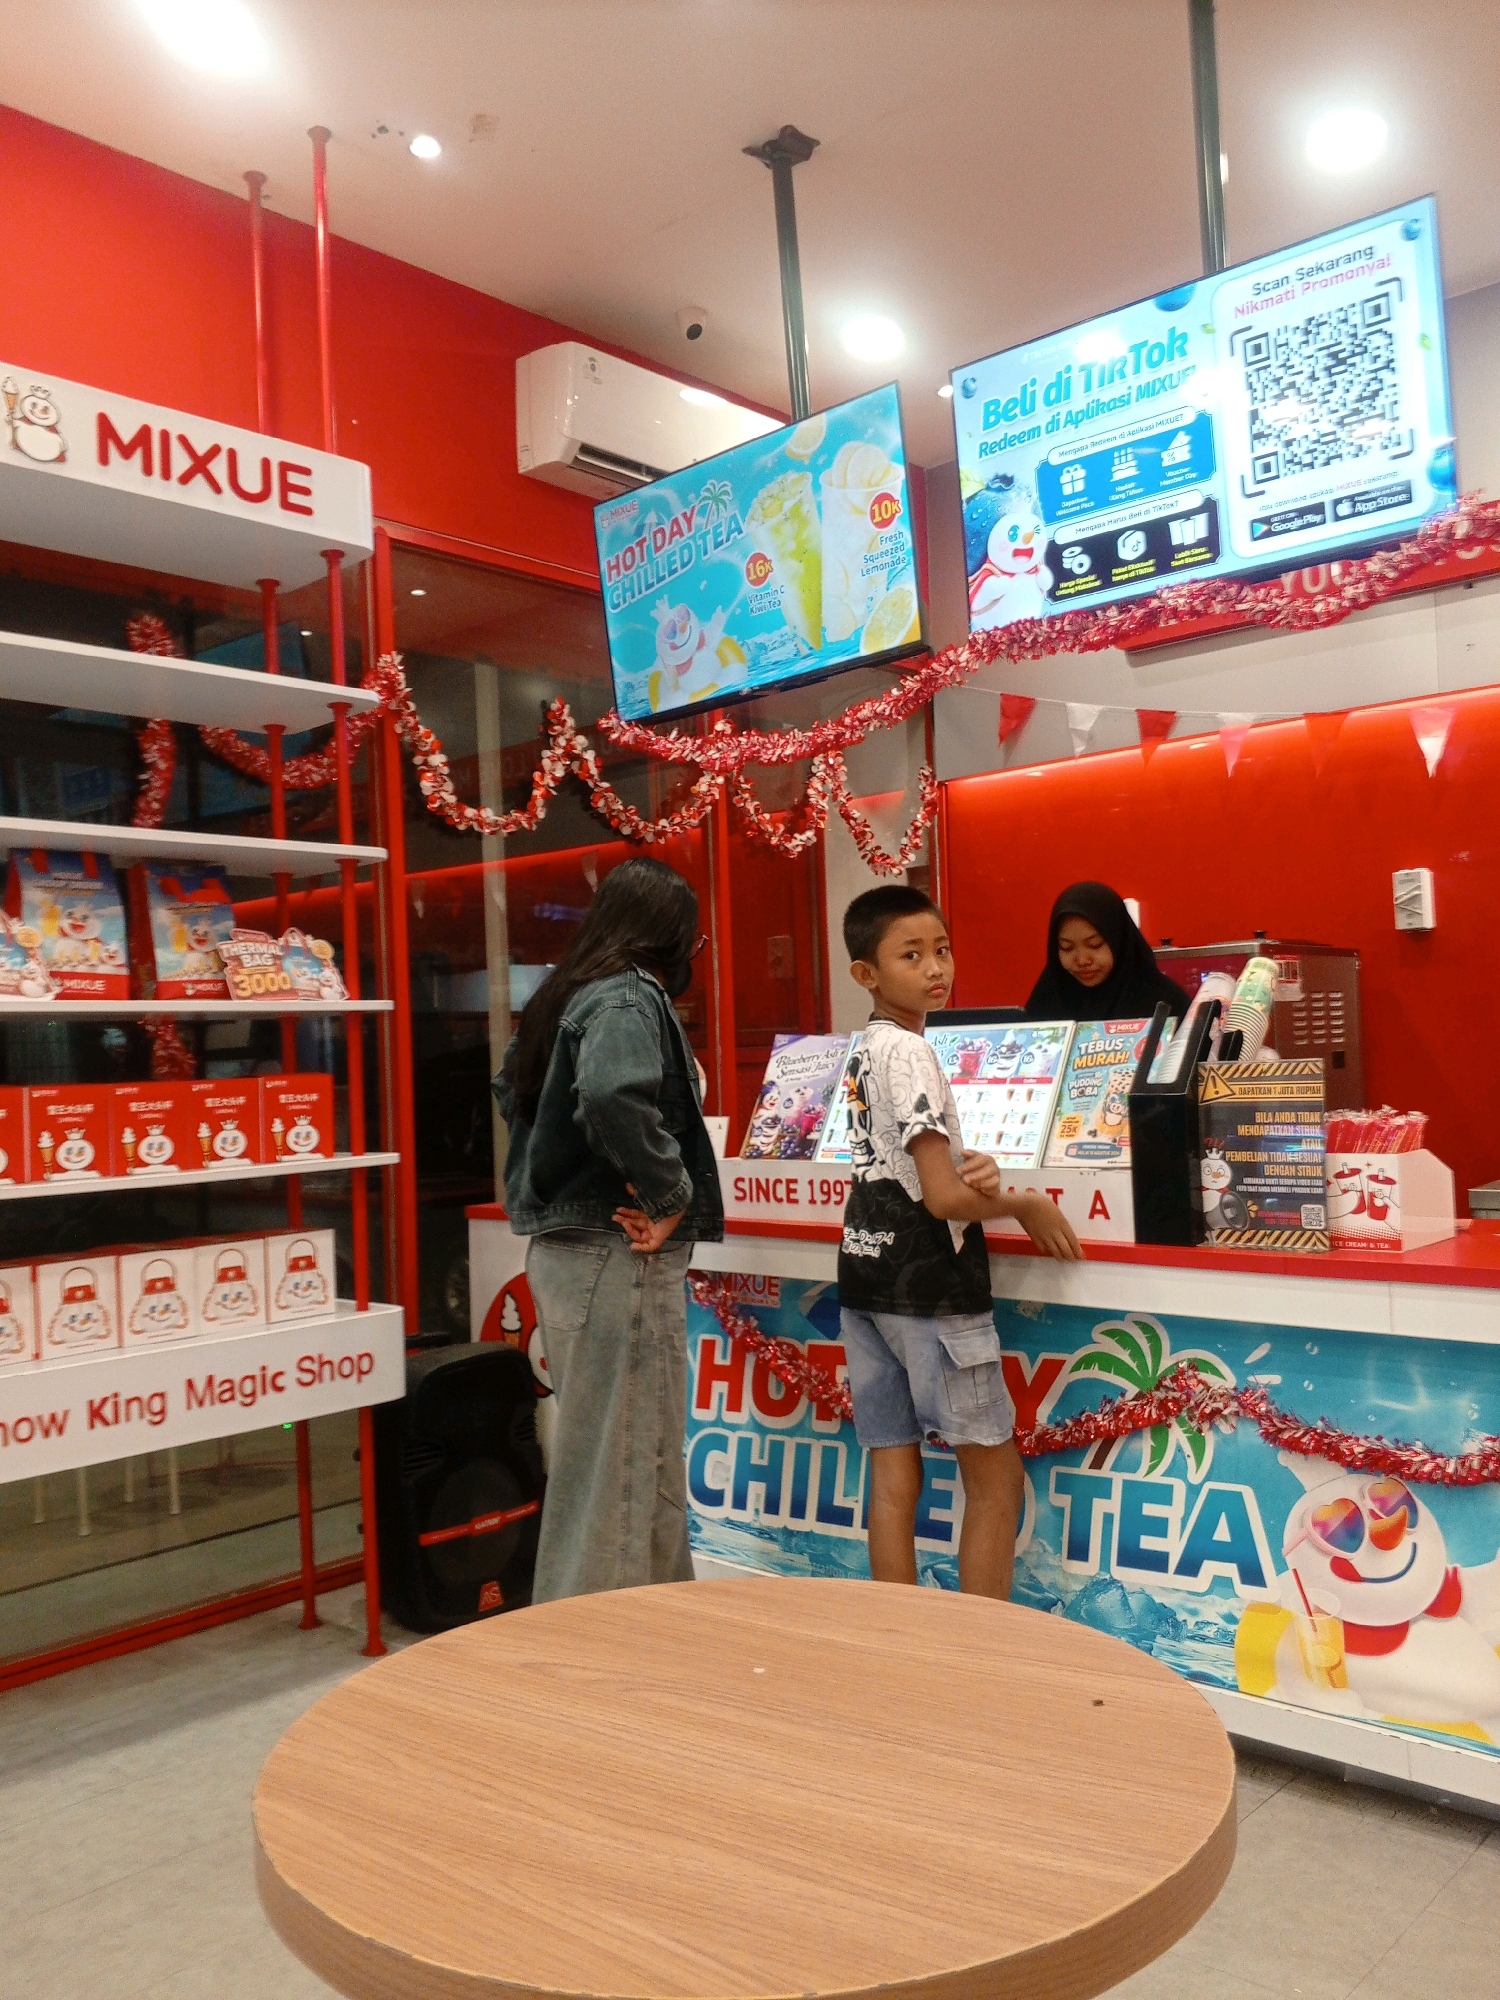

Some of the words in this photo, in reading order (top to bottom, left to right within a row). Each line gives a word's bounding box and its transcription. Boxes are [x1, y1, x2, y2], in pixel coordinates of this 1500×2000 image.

[1252, 275, 1289, 296] Scan
[1295, 246, 1375, 281] Sekarang
[1234, 285, 1295, 319] Nikmati
[1301, 253, 1392, 295] Promonya!
[982, 378, 1037, 431] Beli
[1043, 364, 1072, 407] di
[1078, 326, 1188, 394] TikTok
[978, 422, 1041, 459] Redeem
[1045, 412, 1061, 434] di
[1063, 386, 1131, 429] Aplikasi
[1059, 444, 1088, 458] Mengapa
[1156, 413, 1184, 429] MIXUE?
[96, 412, 314, 516] MIXUE
[1336, 479, 1362, 491] MIXUE
[872, 499, 901, 524] 10K
[1355, 500, 1377, 514] App
[1377, 492, 1410, 508] Store
[1271, 518, 1302, 532] Google
[1303, 513, 1324, 526] Play
[606, 537, 648, 583] HOT
[652, 505, 697, 554] DAY
[879, 531, 904, 546] Fresh
[608, 543, 694, 611] CHILLED
[699, 513, 744, 557] TEA
[863, 542, 906, 564] Squeezed
[747, 559, 772, 582] 16K
[861, 555, 907, 577] Lemonade
[748, 587, 779, 604] Vitamin
[780, 585, 785, 594] C
[750, 604, 767, 615] Kiwi
[768, 600, 782, 611] Tea
[241, 954, 274, 968] BAG
[233, 972, 292, 997] 3000
[1079, 1038, 1125, 1055] TEBUS
[1074, 1051, 1131, 1070] MURAH!
[1069, 1078, 1102, 1090] PUDDING
[1070, 1087, 1098, 1099] BOBA
[1239, 1087, 1272, 1096] DAPATKAN
[1278, 1086, 1294, 1095] JUTA
[1296, 1085, 1321, 1095] RUPIAH
[1255, 1112, 1273, 1123] BILA
[1274, 1112, 1296, 1123] ANDA
[1297, 1112, 1320, 1122] TIDAK
[1237, 1124, 1294, 1136] MENDAPATKAN
[1296, 1124, 1321, 1135] STRUK
[1301, 1139, 1321, 1149] ATAU
[1225, 1151, 1268, 1162] PEMBELIAN
[1264, 1165, 1296, 1176] DENGAN
[1297, 1165, 1322, 1176] STRUK
[733, 1177, 799, 1204] SINCE
[1088, 1189, 1111, 1220] A
[87, 1391, 167, 1430] King
[185, 1364, 286, 1411] Magic
[295, 1352, 374, 1387] Shop
[694, 1338, 850, 1424] HOT
[688, 1430, 1028, 1548] CHILE
[1053, 1470, 1268, 1588] TEA
